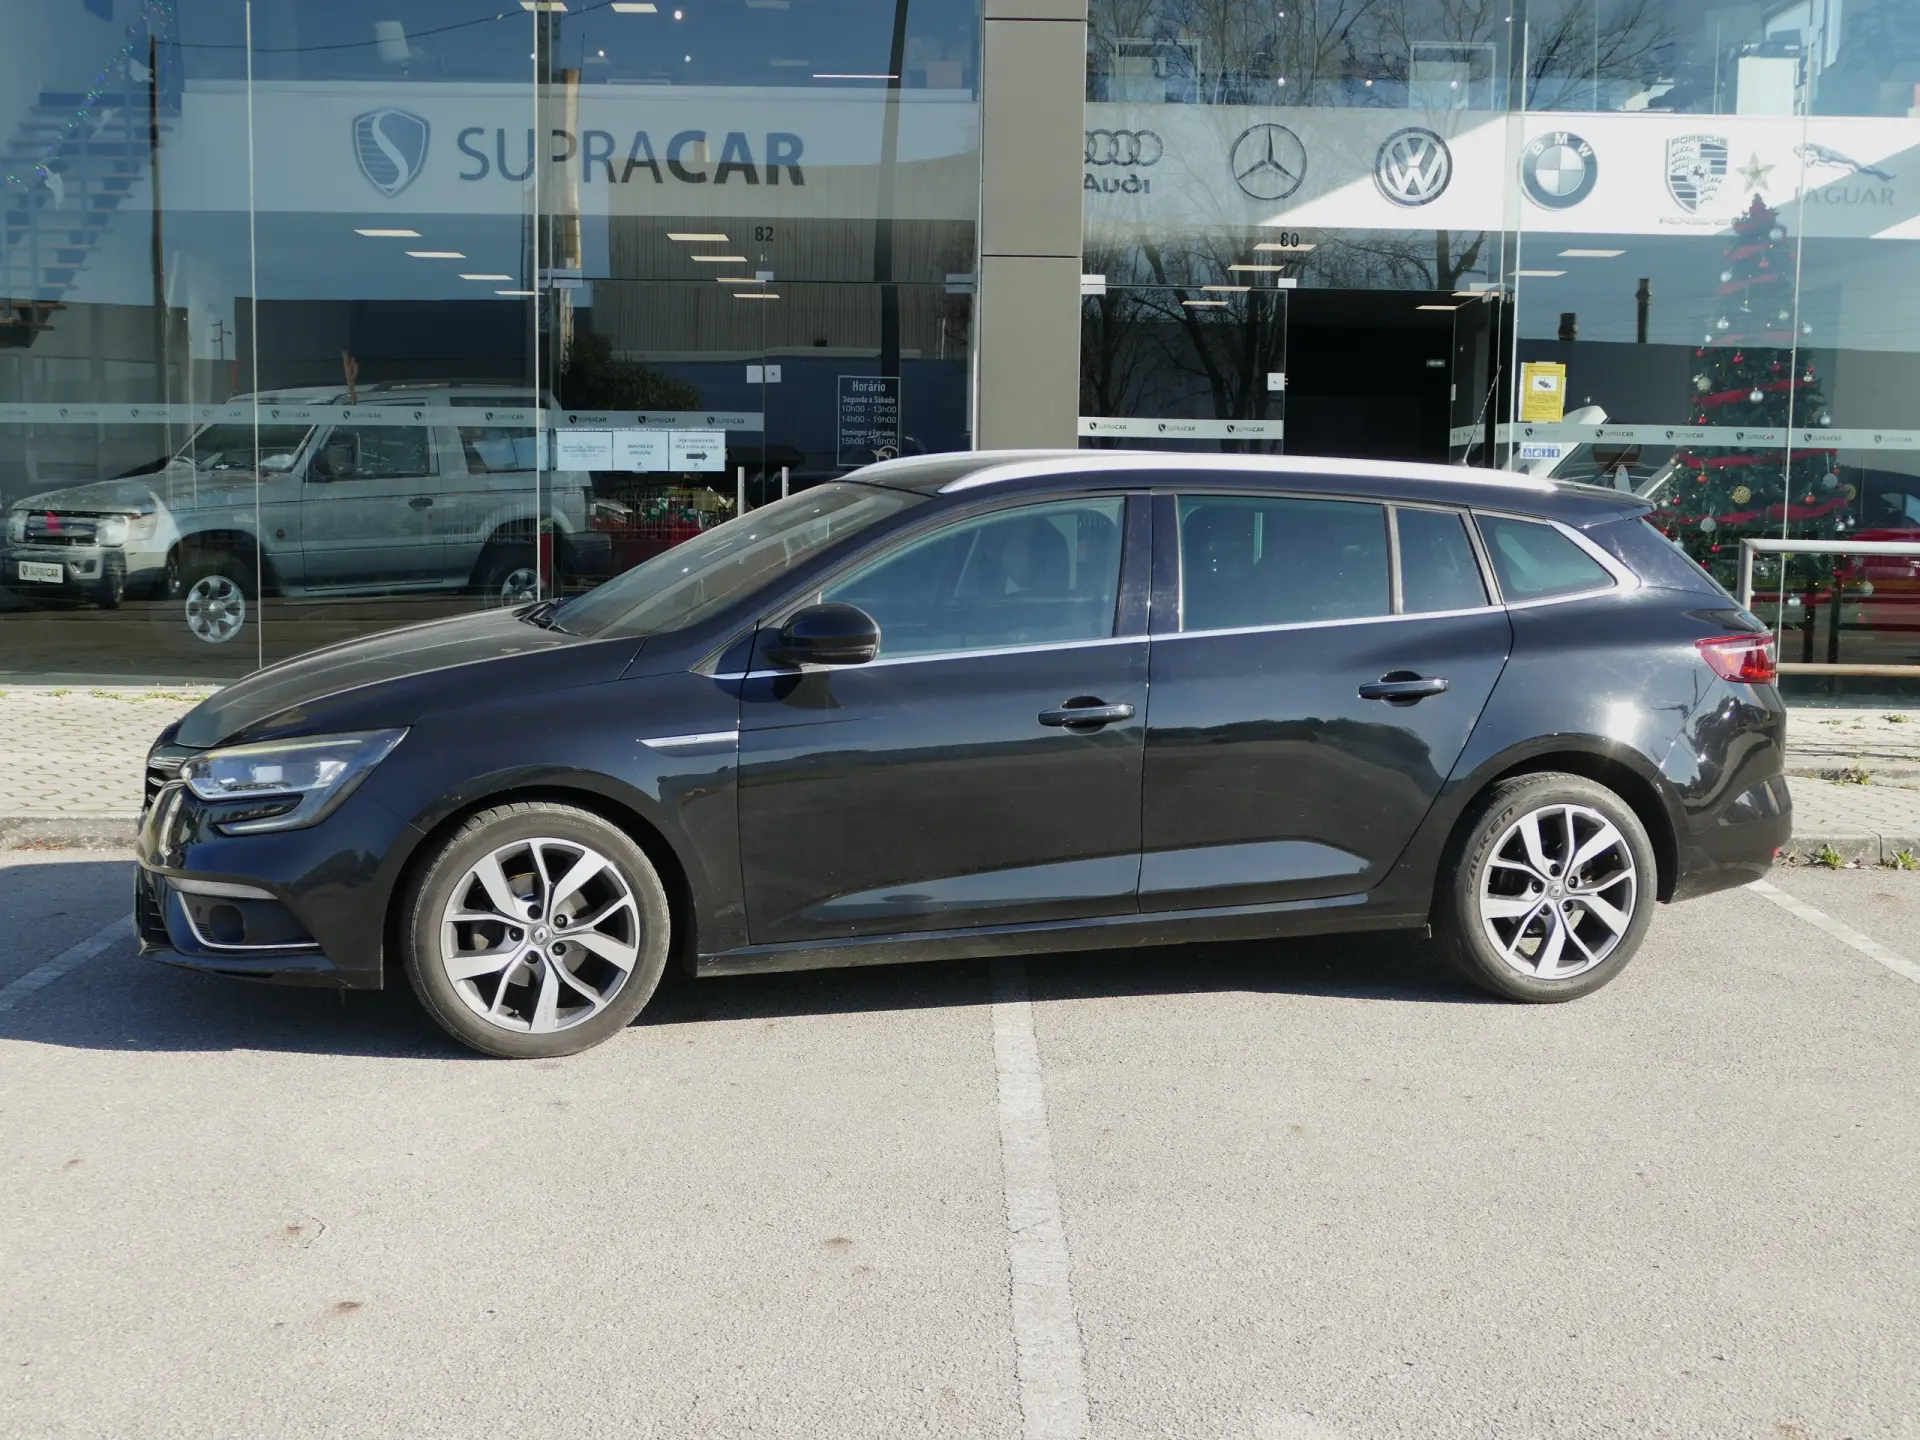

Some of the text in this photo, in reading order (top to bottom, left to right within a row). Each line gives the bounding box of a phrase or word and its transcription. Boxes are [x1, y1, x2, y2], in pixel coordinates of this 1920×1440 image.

[1530, 132, 1593, 158] BMW
[457, 126, 806, 186] SUPRACAR
[1084, 173, 1151, 194] Audi
[1794, 186, 1896, 206] JAGUAR
[754, 226, 774, 242] 82
[1279, 232, 1299, 248] 80
[852, 380, 886, 392] Horário
[842, 395, 868, 404] Segunda
[841, 405, 865, 413] 10h00
[873, 405, 897, 413] 13h00
[841, 415, 865, 423] 14h00
[873, 416, 897, 424] 19h00
[841, 428, 867, 437] Domingos
[1097, 423, 1127, 431] SUPRACAR
[841, 437, 865, 445] 15h00
[873, 438, 897, 446] 18h00
